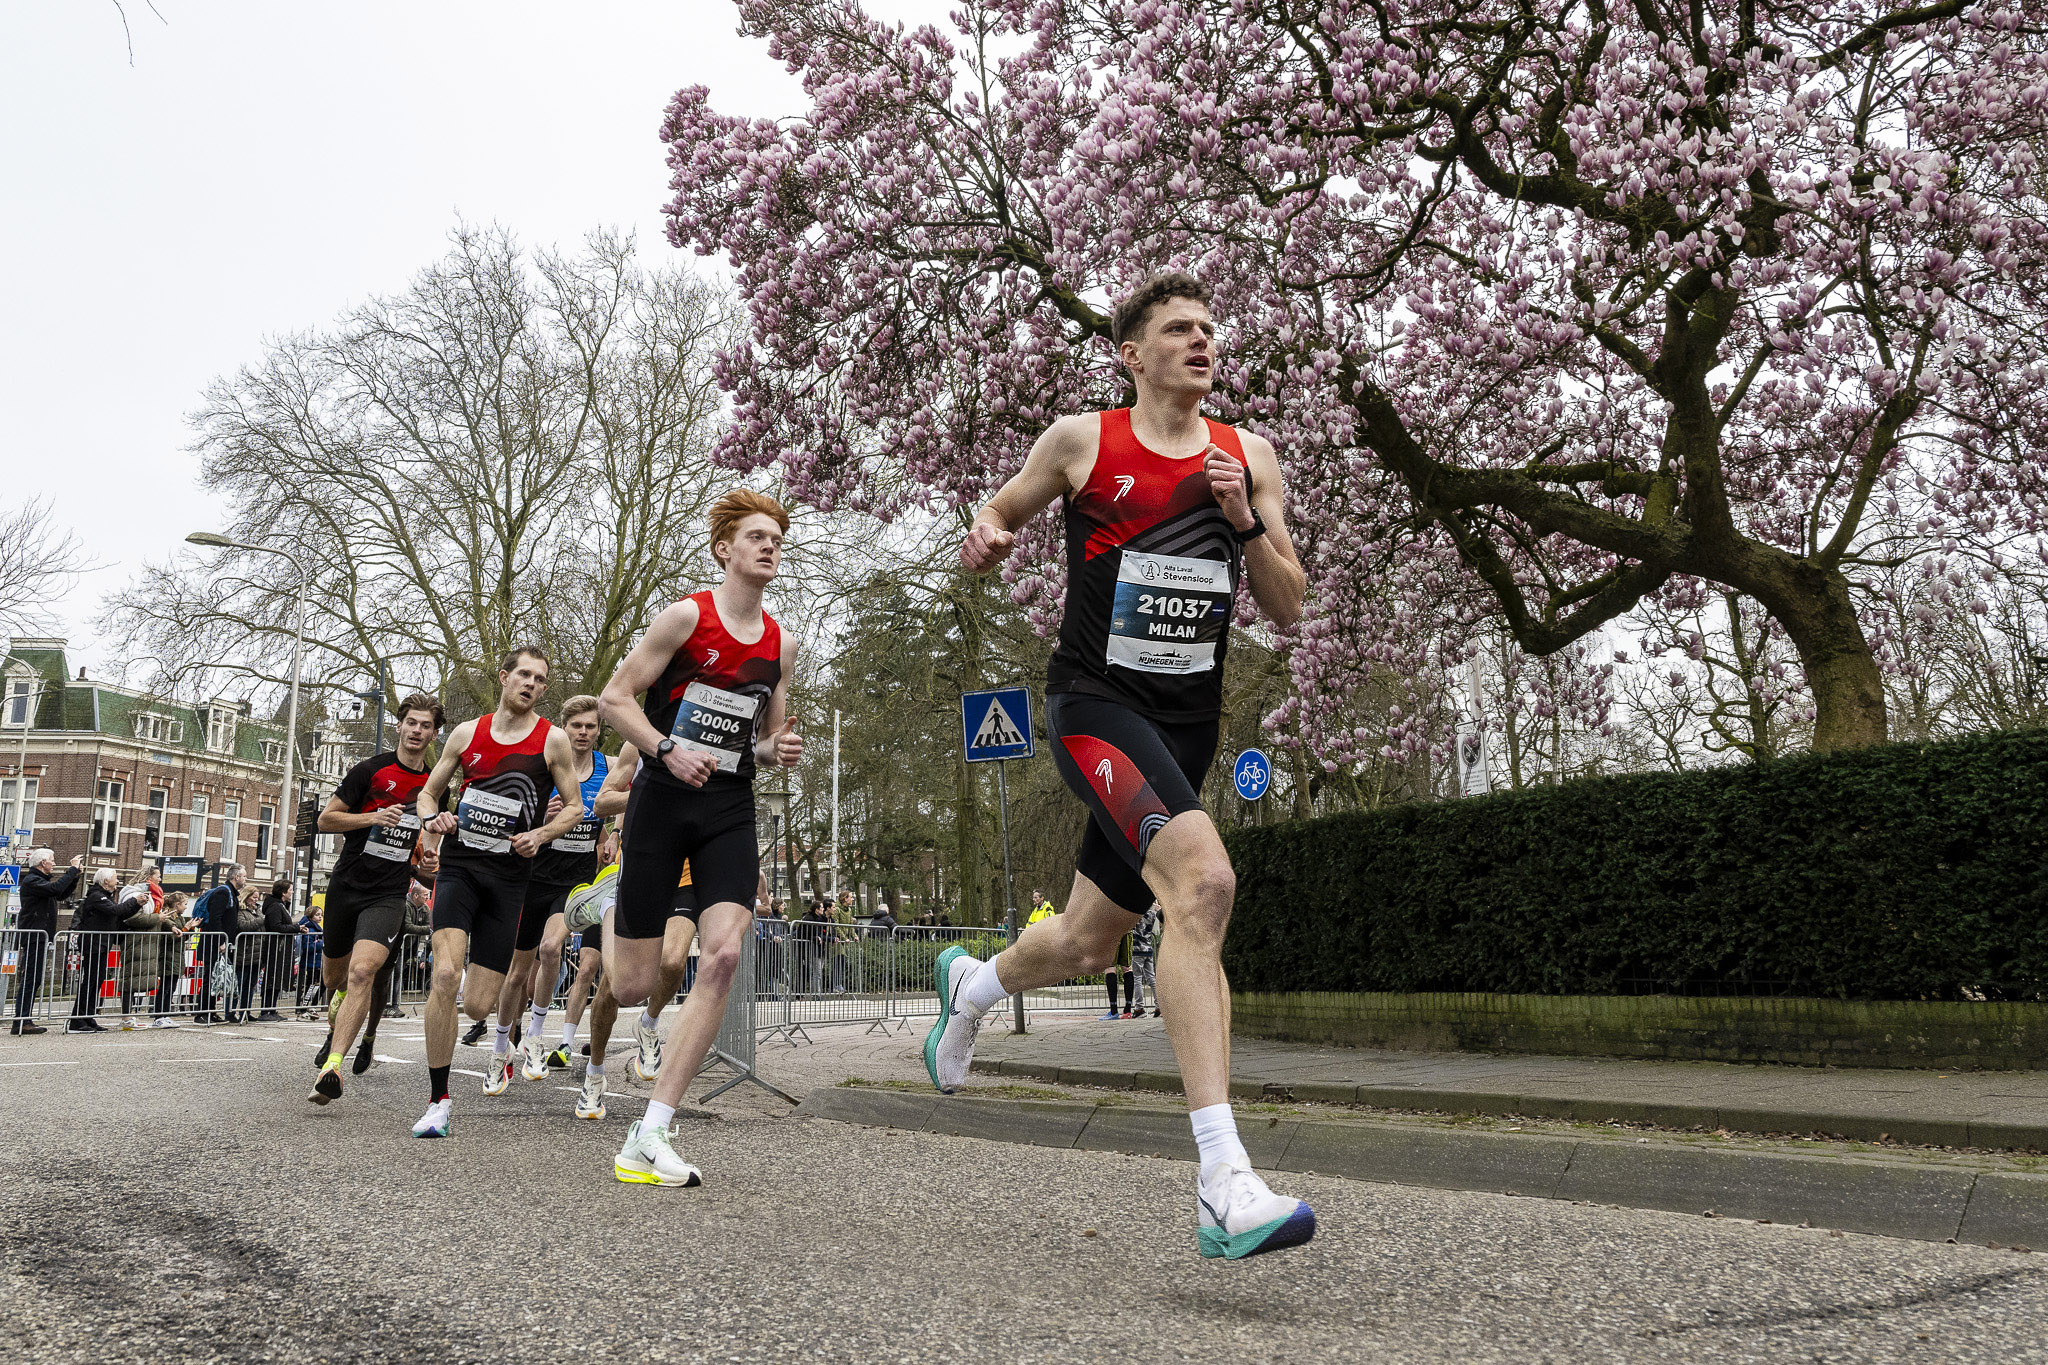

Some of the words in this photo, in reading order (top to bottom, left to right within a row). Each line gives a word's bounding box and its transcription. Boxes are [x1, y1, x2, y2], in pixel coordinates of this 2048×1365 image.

[1163, 572, 1214, 585] Stevensloop
[1136, 594, 1212, 619] 21037
[1148, 622, 1197, 639] MILAN
[712, 699, 745, 712] Stevensloop
[690, 709, 740, 734] 20006
[700, 731, 724, 744] LEVI
[467, 809, 507, 827] 20002
[381, 826, 412, 840] 21041
[469, 823, 499, 836] MARCO
[385, 837, 403, 847] TEUN
